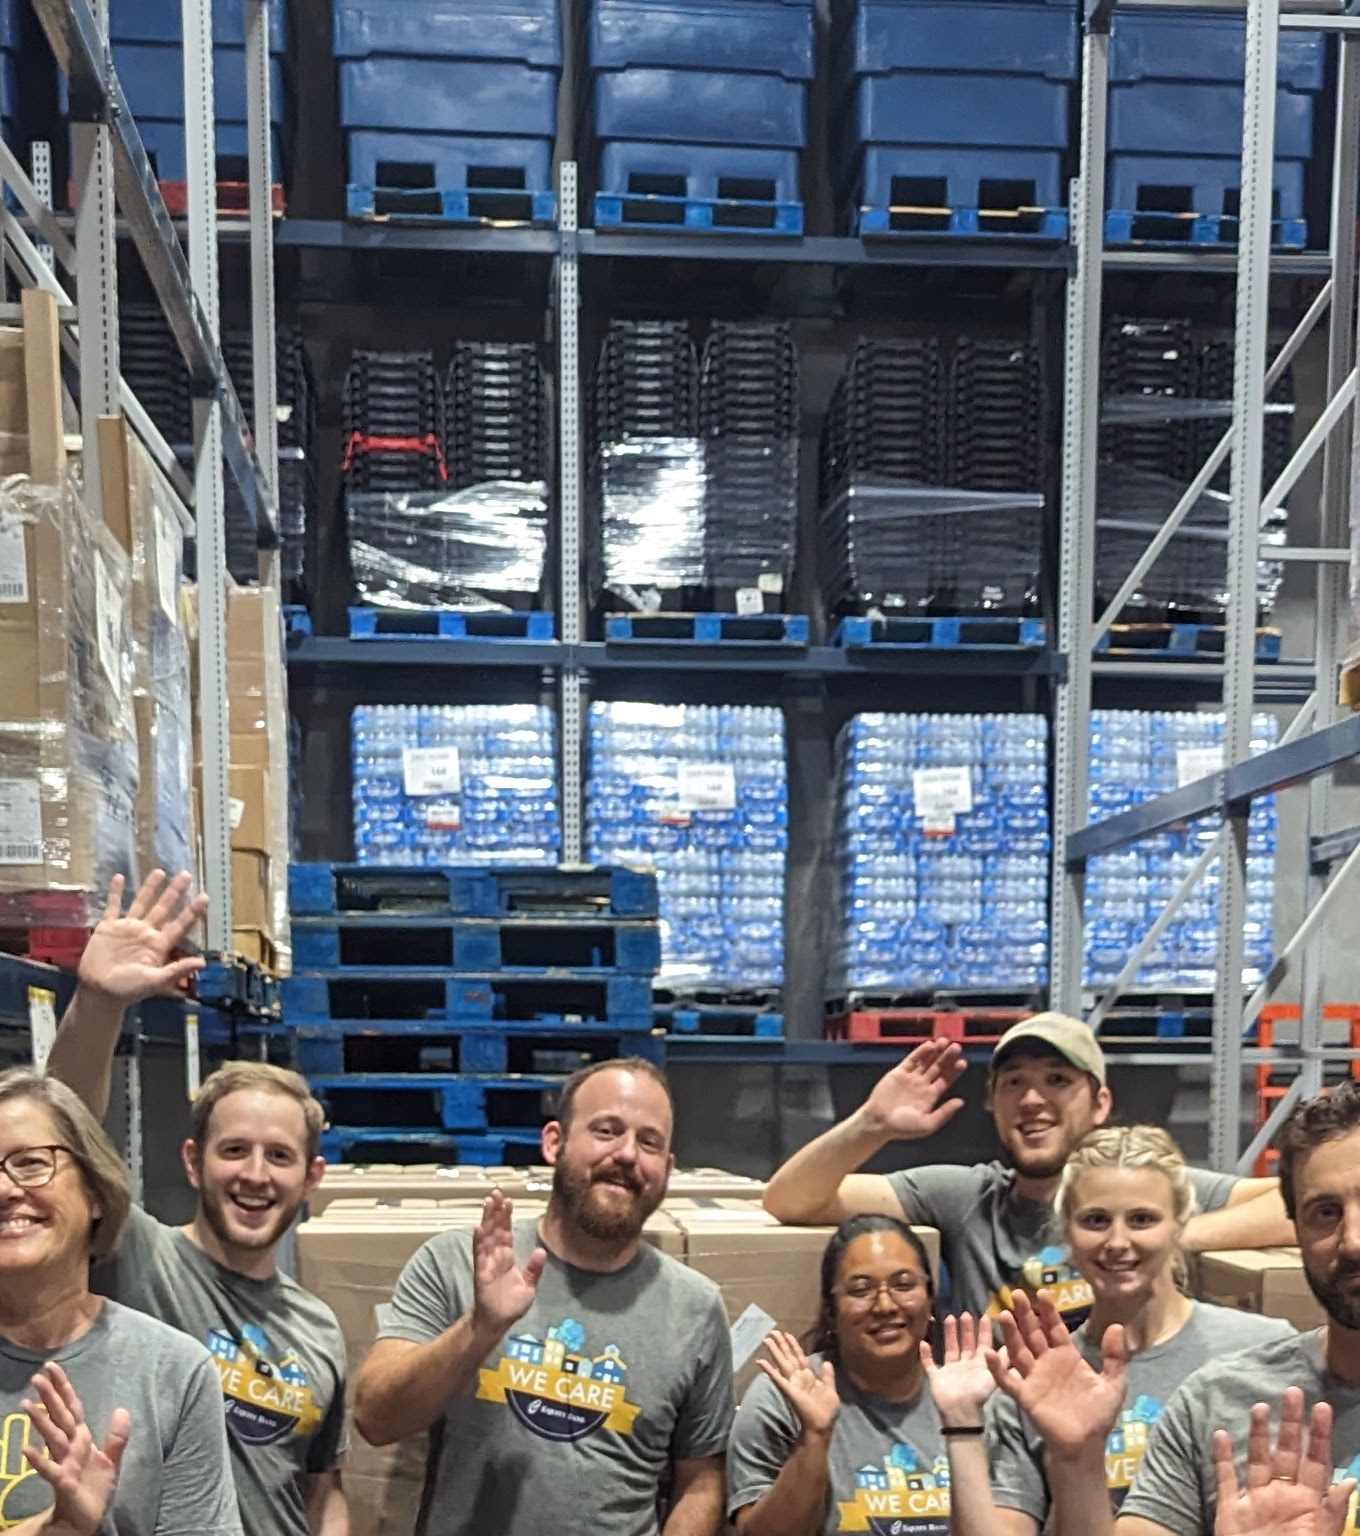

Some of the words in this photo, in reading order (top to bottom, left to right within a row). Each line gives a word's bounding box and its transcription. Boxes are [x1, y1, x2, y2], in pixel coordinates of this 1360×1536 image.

[248, 1378, 305, 1412] CARE
[509, 1364, 547, 1393] WE
[555, 1377, 616, 1409] CARE
[864, 1492, 902, 1513] WE
